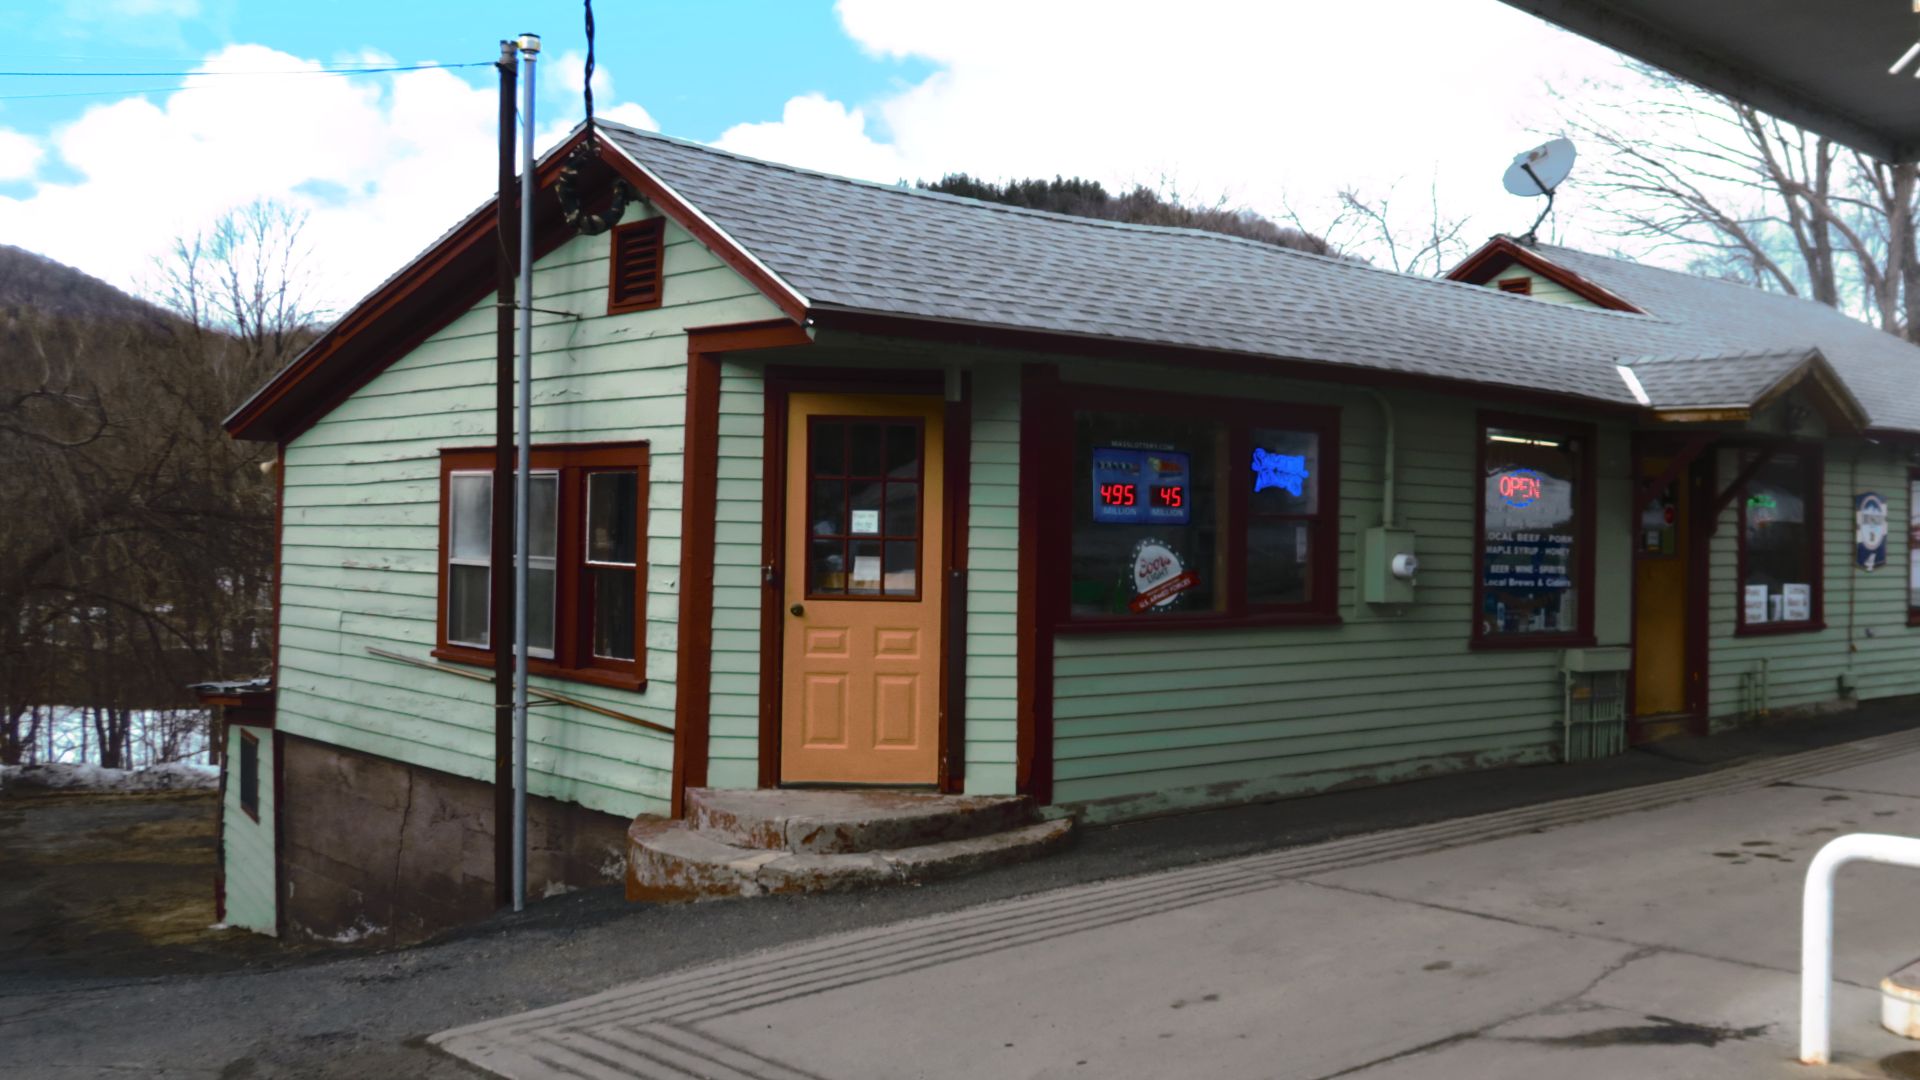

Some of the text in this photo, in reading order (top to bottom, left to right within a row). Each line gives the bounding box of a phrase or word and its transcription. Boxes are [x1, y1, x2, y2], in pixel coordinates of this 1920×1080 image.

[1499, 476, 1541, 499] OPEN
[1101, 484, 1134, 506] 495
[1160, 487, 1181, 507] 45
[1103, 506, 1136, 516] MILLION
[1151, 508, 1184, 517] MILLION
[1517, 533, 1540, 543] BEEF
[1549, 535, 1573, 543] PORK
[1486, 545, 1570, 556] MAPLE SYRUP HONEY
[1139, 556, 1172, 578] Coors
[1490, 564, 1565, 574] BEER WINE SPIRITS
[1147, 568, 1168, 583] LIGHT
[1483, 578, 1506, 587] Local
[1509, 578, 1535, 587] Brews
[1537, 578, 1544, 587] &
